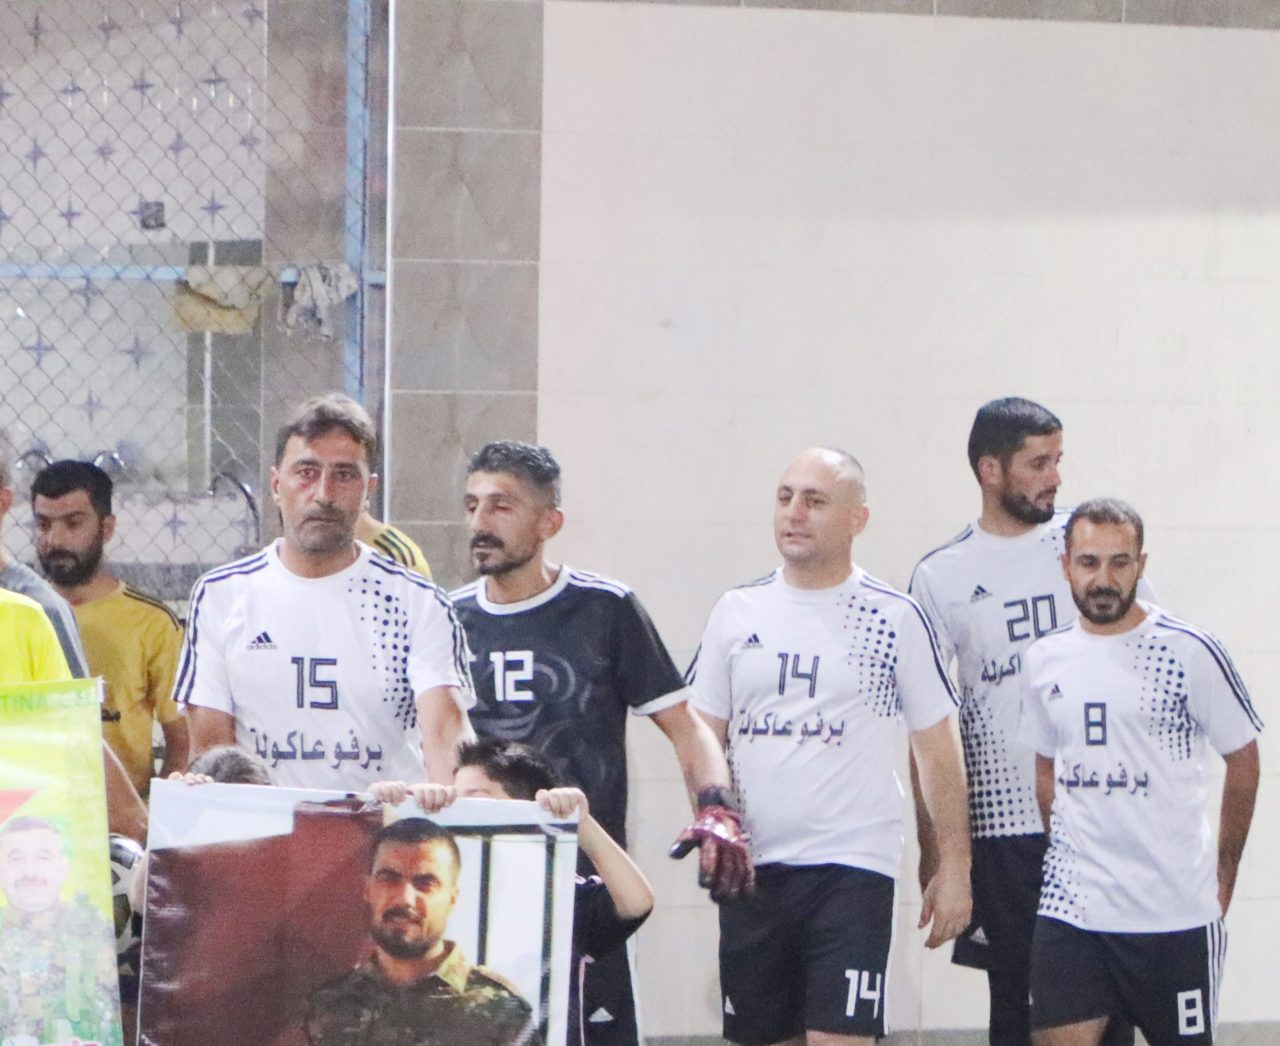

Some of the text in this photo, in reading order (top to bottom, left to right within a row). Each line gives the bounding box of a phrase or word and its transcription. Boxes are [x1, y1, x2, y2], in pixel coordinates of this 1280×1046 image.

[1004, 594, 1058, 642] 20
[291, 656, 338, 710] 15
[489, 650, 534, 702] 12
[777, 652, 820, 698] 14
[1084, 702, 1107, 746] 8
[845, 969, 881, 1018] 14
[1177, 988, 1205, 1036] 8
